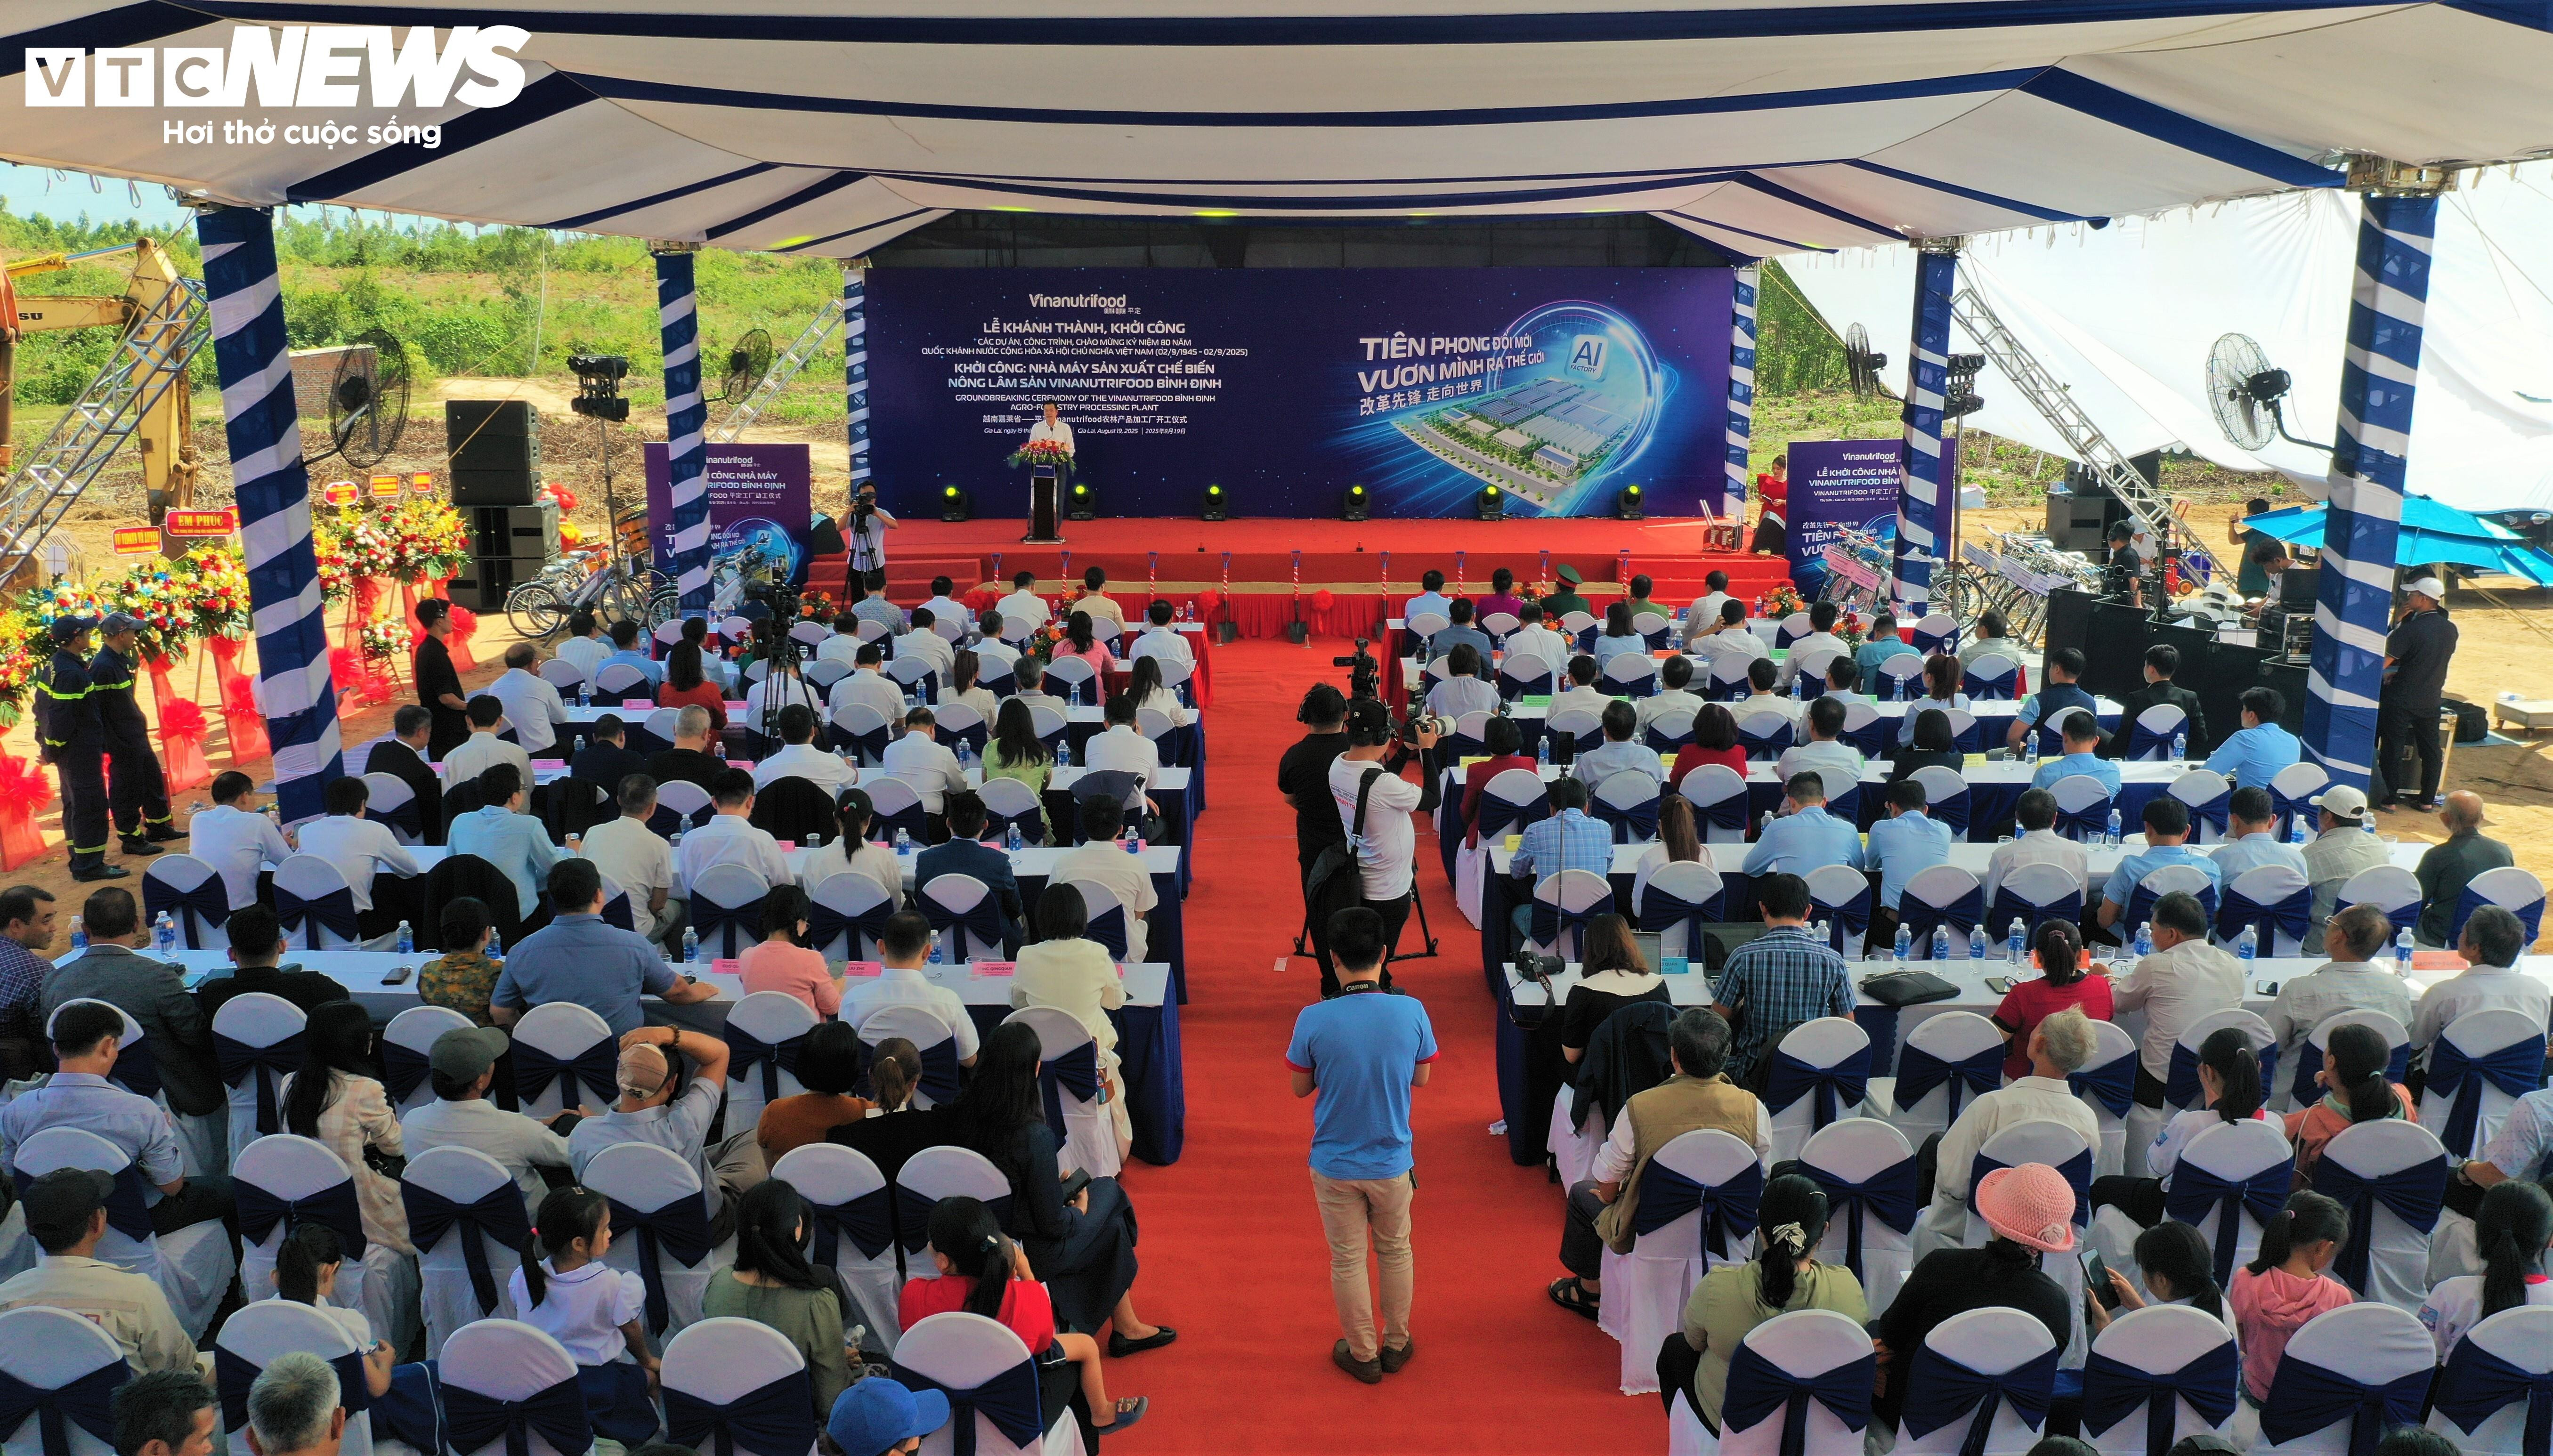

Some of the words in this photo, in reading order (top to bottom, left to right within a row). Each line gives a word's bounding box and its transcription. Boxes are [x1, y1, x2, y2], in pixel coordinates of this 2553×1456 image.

[1029, 294, 1126, 307] Vinanutrifood
[983, 317, 1000, 332] LỄ
[1003, 320, 1052, 332] KHÁNH
[1054, 320, 1107, 334] THÀNH,
[1110, 320, 1143, 333] KHỞI
[1147, 321, 1185, 333] CÔNG
[978, 337, 994, 345] CÁC
[996, 338, 1007, 346] DỰ
[1008, 337, 1021, 346] ÁN,
[1024, 337, 1046, 345] CÔNG
[1047, 337, 1074, 346] TRÌNH,
[1076, 338, 1098, 346] CHÀO
[1100, 338, 1125, 346] MỪNG
[1126, 337, 1136, 346] KỶ
[1138, 338, 1159, 347] NIỆM
[1172, 338, 1191, 346] NĂM
[1360, 331, 1425, 360] TIÊN
[1431, 337, 1490, 356] PHONG
[1492, 331, 1513, 350] ĐỔI
[1515, 332, 1532, 348] MỚI
[922, 345, 945, 355] QUỐC
[946, 346, 974, 354] KHÁNH
[976, 346, 998, 354] NƯỚC
[1000, 346, 1023, 356] CỘNG
[1025, 346, 1042, 355] HÒA
[1055, 347, 1070, 356] HỘI
[1071, 347, 1087, 355] CHỦ
[1089, 347, 1114, 355] NGHĨA
[1115, 347, 1133, 356] VIỆT
[1204, 348, 1248, 356] 02/9/2025)
[1572, 341, 1602, 366] AI
[955, 361, 985, 373] KHỞI
[988, 361, 1026, 373] CÔNG:
[1029, 361, 1057, 373] NHÀ
[1060, 361, 1088, 373] MÁY
[1092, 361, 1118, 373] SẢN
[1120, 359, 1155, 373] XUẤT
[1158, 360, 1183, 373] CHẾ
[1185, 360, 1215, 374] BIẾN
[1357, 364, 1435, 393] VƯƠN
[1440, 357, 1483, 380] MÌNH
[1486, 356, 1504, 372] RA
[1506, 348, 1526, 368] THẾ
[1528, 350, 1545, 364] GIỚI
[1570, 364, 1597, 373] FACTORY
[948, 376, 985, 388] NÔNG
[989, 376, 1017, 388] LÂM
[1020, 375, 1046, 388] SẢN
[1047, 379, 1154, 388] VINANUTRIFOOD
[1157, 376, 1187, 388] BÌNH
[1190, 379, 1222, 390] ĐỊNH
[1175, 394, 1194, 402] BÌNH
[1360, 389, 1421, 416] 改革先锋
[1426, 379, 1482, 402] 走向世界
[706, 456, 753, 464] inanutrifood
[1843, 452, 1895, 461] Vinanutrifood
[711, 471, 735, 479] CÔNG
[737, 471, 755, 479] NHÀ
[757, 471, 778, 479] MÁY
[1817, 467, 1828, 477] LỄ
[1829, 467, 1850, 477] KHỞI
[1852, 467, 1876, 476] CÔNG
[1878, 467, 1897, 476] NHÀ
[741, 480, 762, 489] BÌNH
[1808, 478, 1880, 487] VINANUTRIFOOD
[178, 515, 193, 526] EM
[196, 513, 223, 526] PHÚC
[1802, 530, 1831, 543] TIÊN
[1346, 983, 1369, 991] Canon
